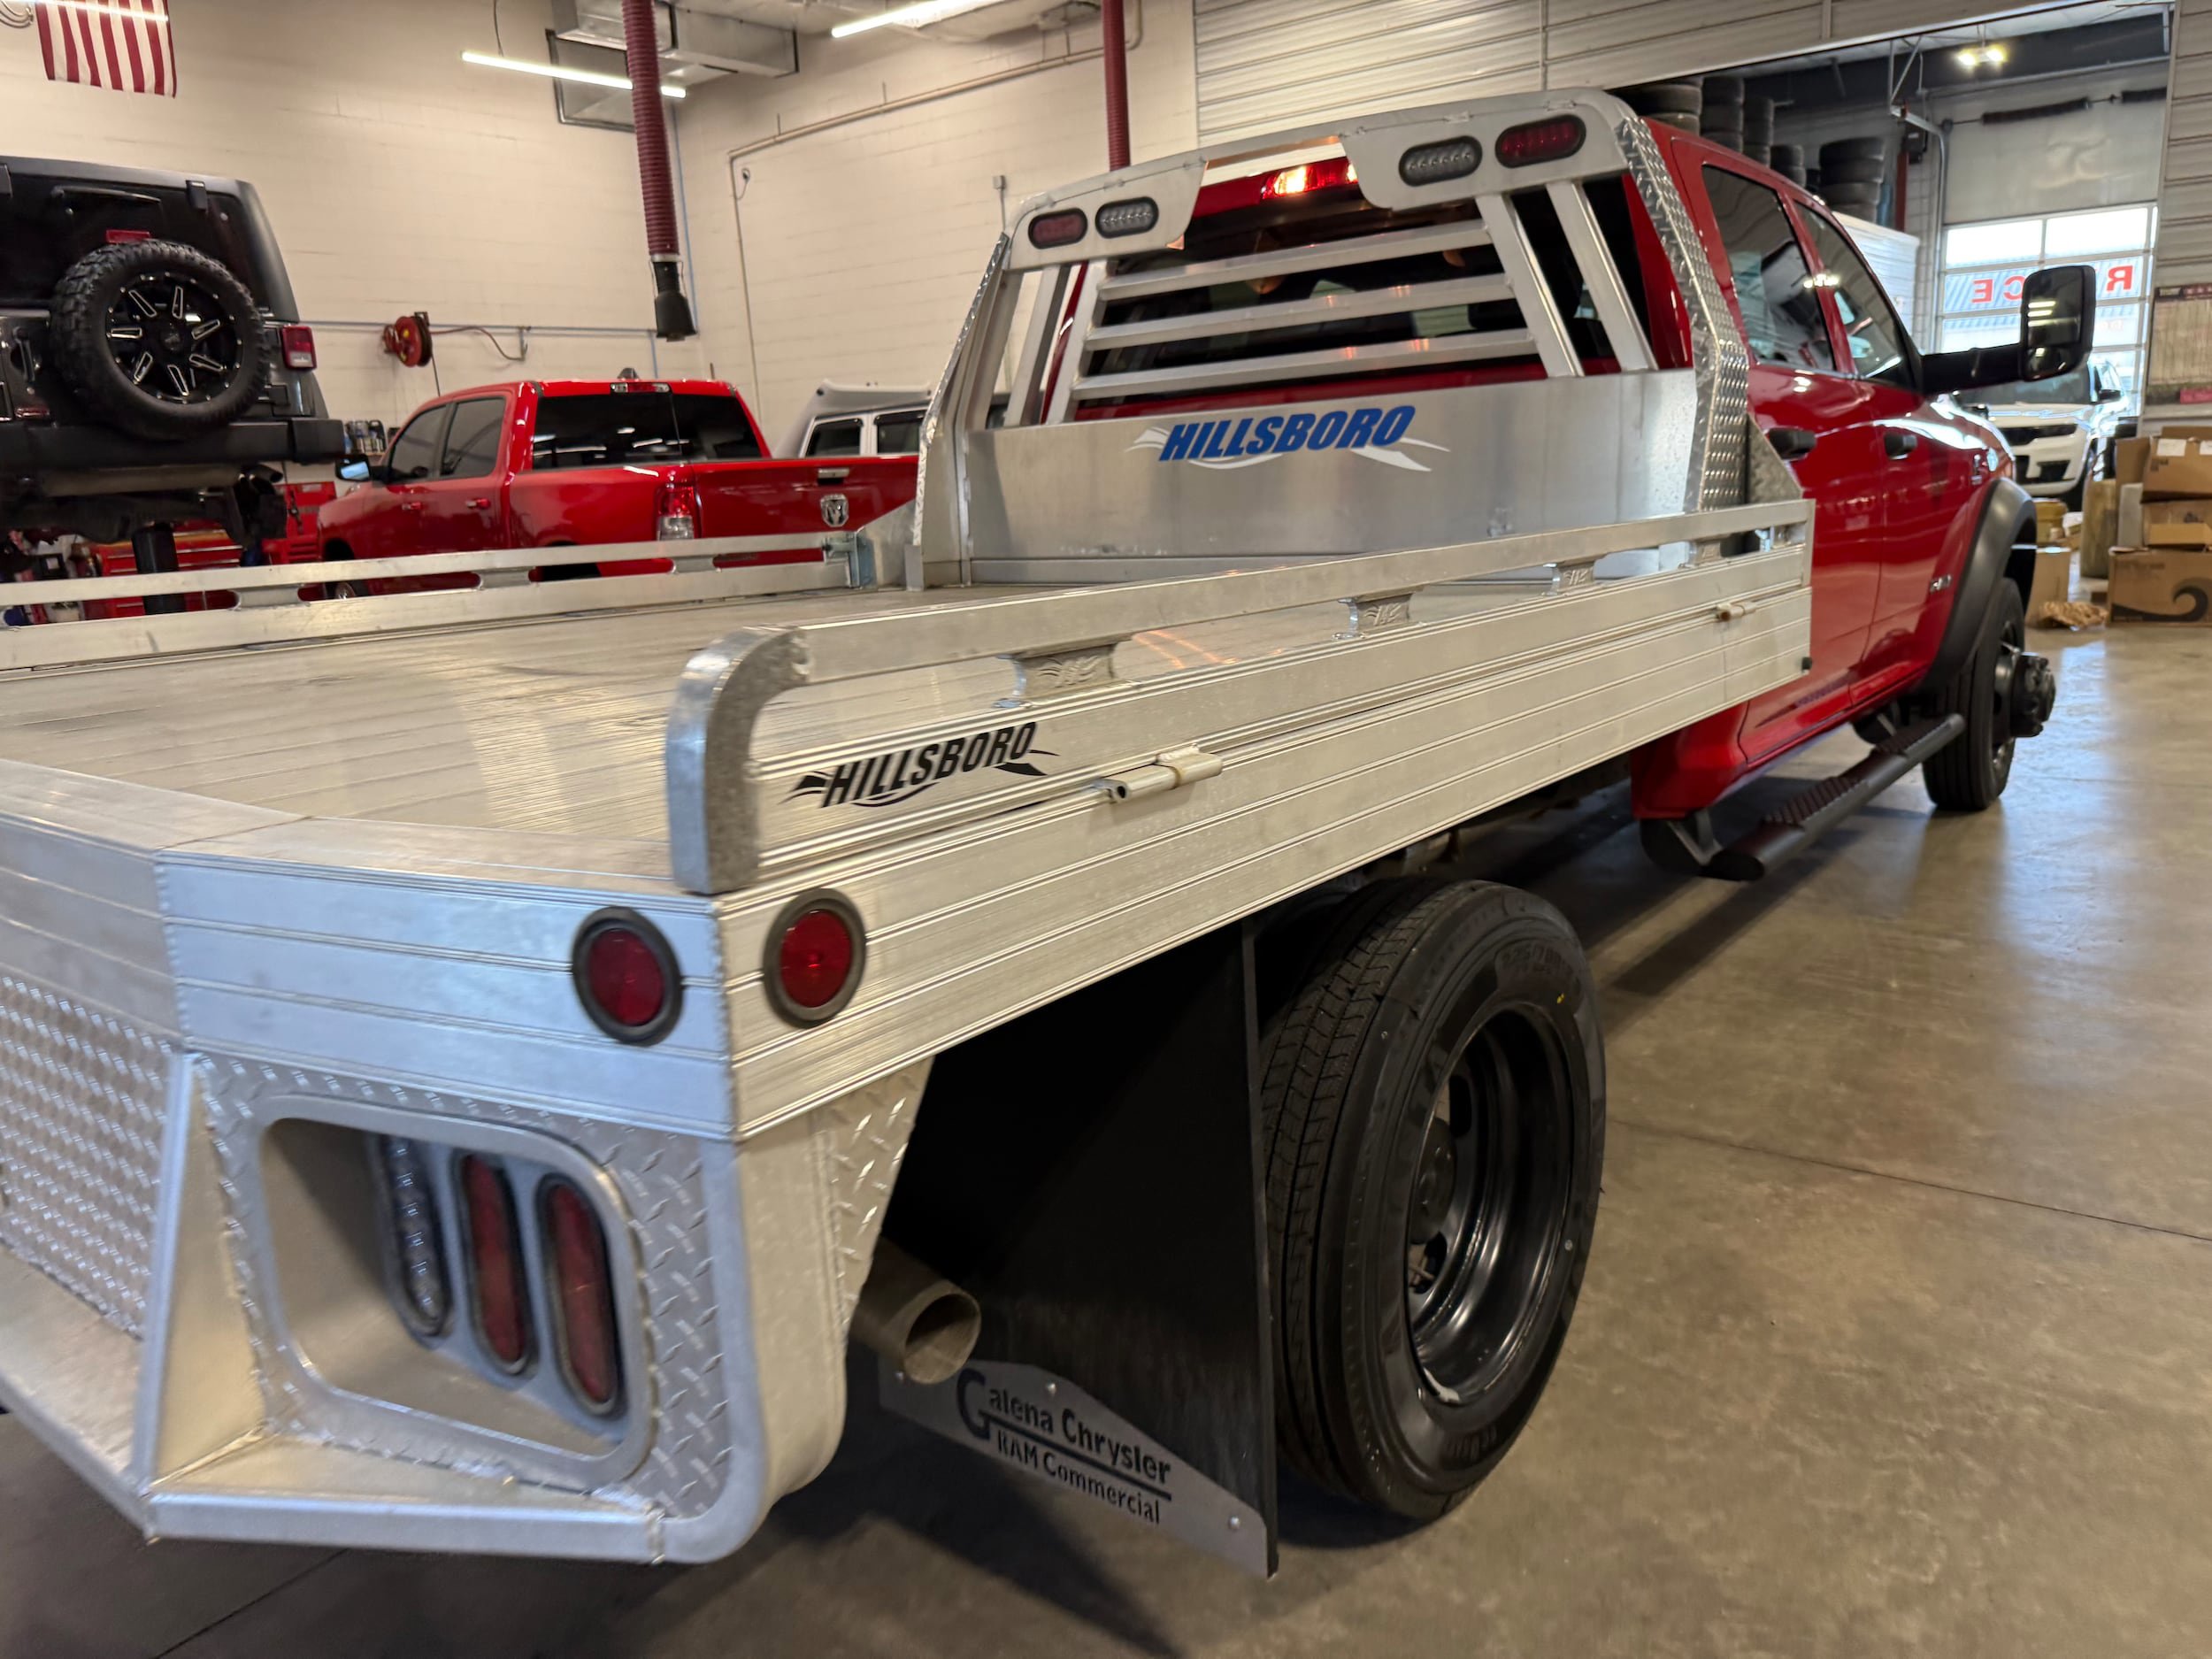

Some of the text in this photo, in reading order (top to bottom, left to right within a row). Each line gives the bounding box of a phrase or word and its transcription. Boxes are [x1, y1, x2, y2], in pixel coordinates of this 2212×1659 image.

[1159, 405, 1416, 462] HILLSBORO
[820, 721, 1036, 808] HILLSBORO
[956, 1368, 1171, 1484] Galena Chrysler
[997, 1430, 1160, 1525] RAM Commercial
